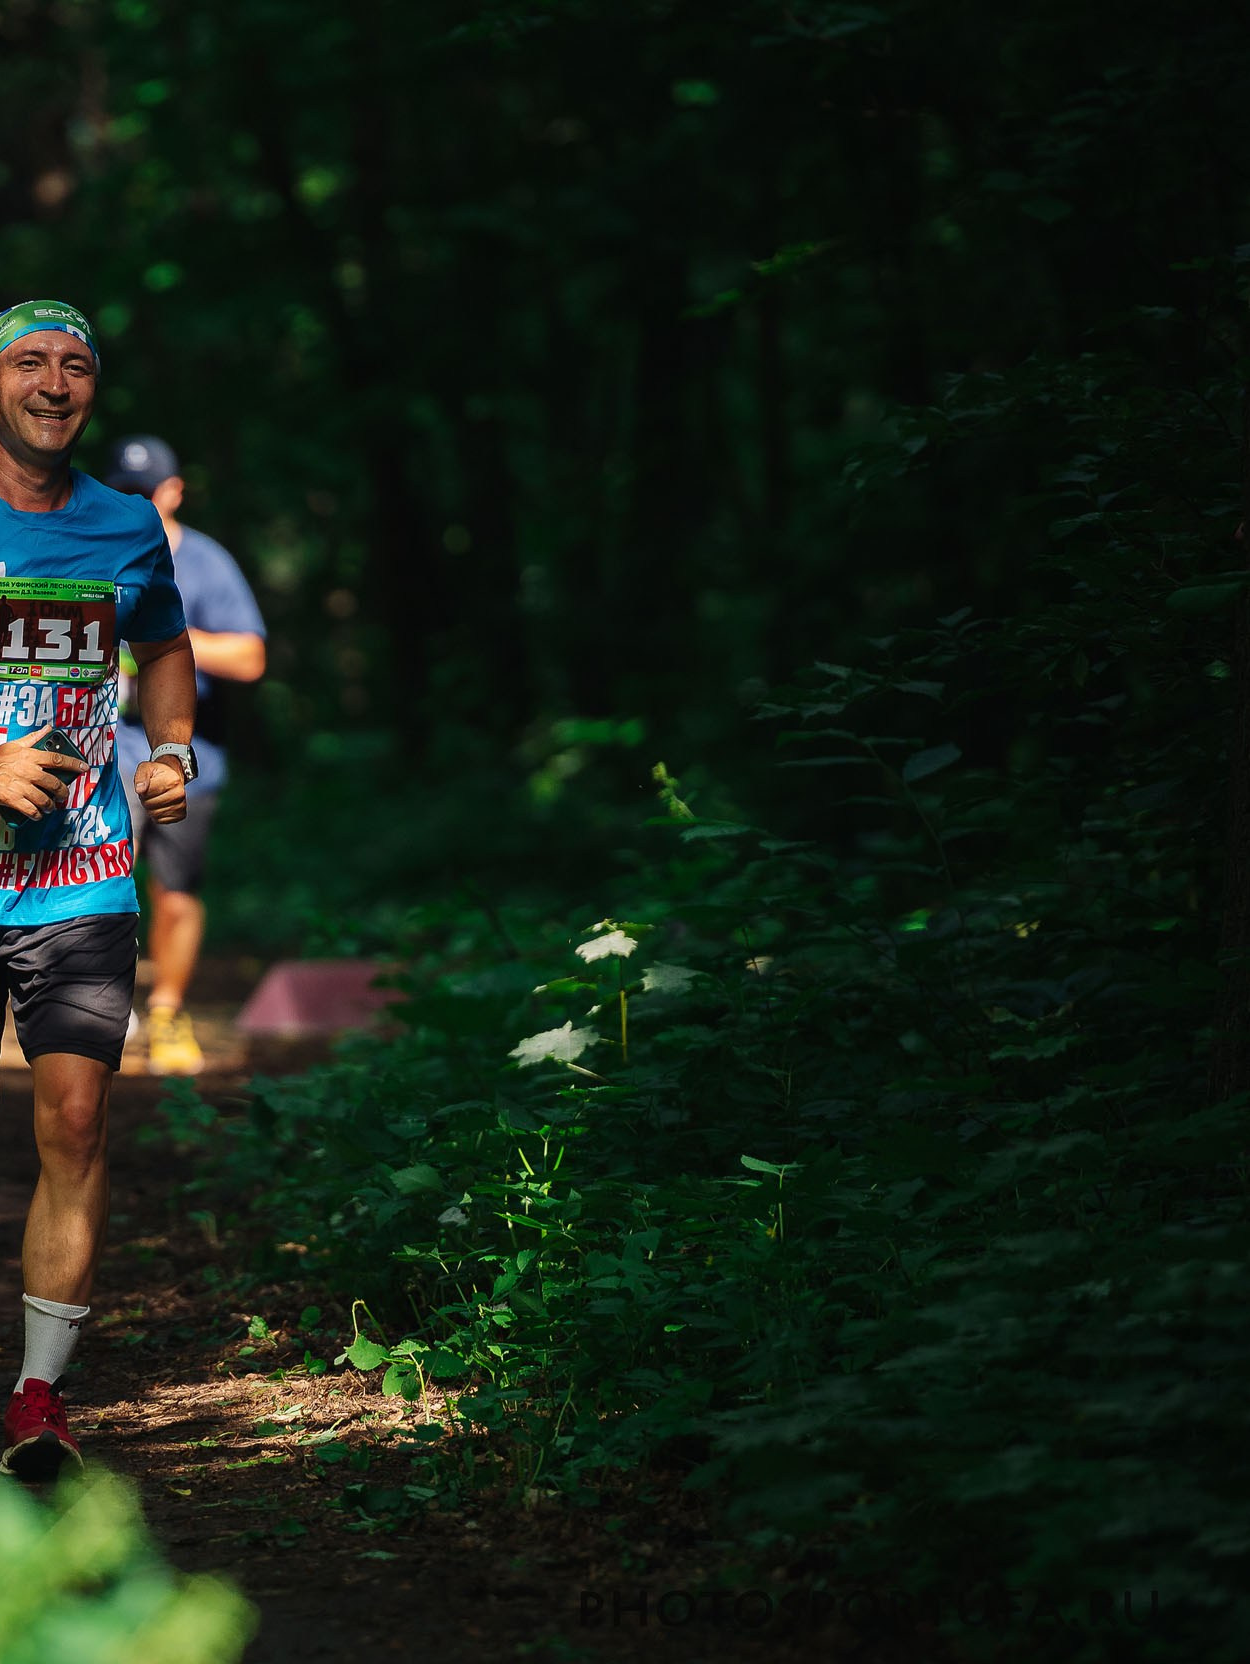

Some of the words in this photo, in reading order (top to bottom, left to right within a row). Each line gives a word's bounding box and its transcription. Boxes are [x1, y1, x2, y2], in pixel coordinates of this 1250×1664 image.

[11, 581, 49, 589] УФИМСКИЙ
[50, 581, 77, 590] ЛЕСНОЙ
[2, 618, 104, 661] 131
